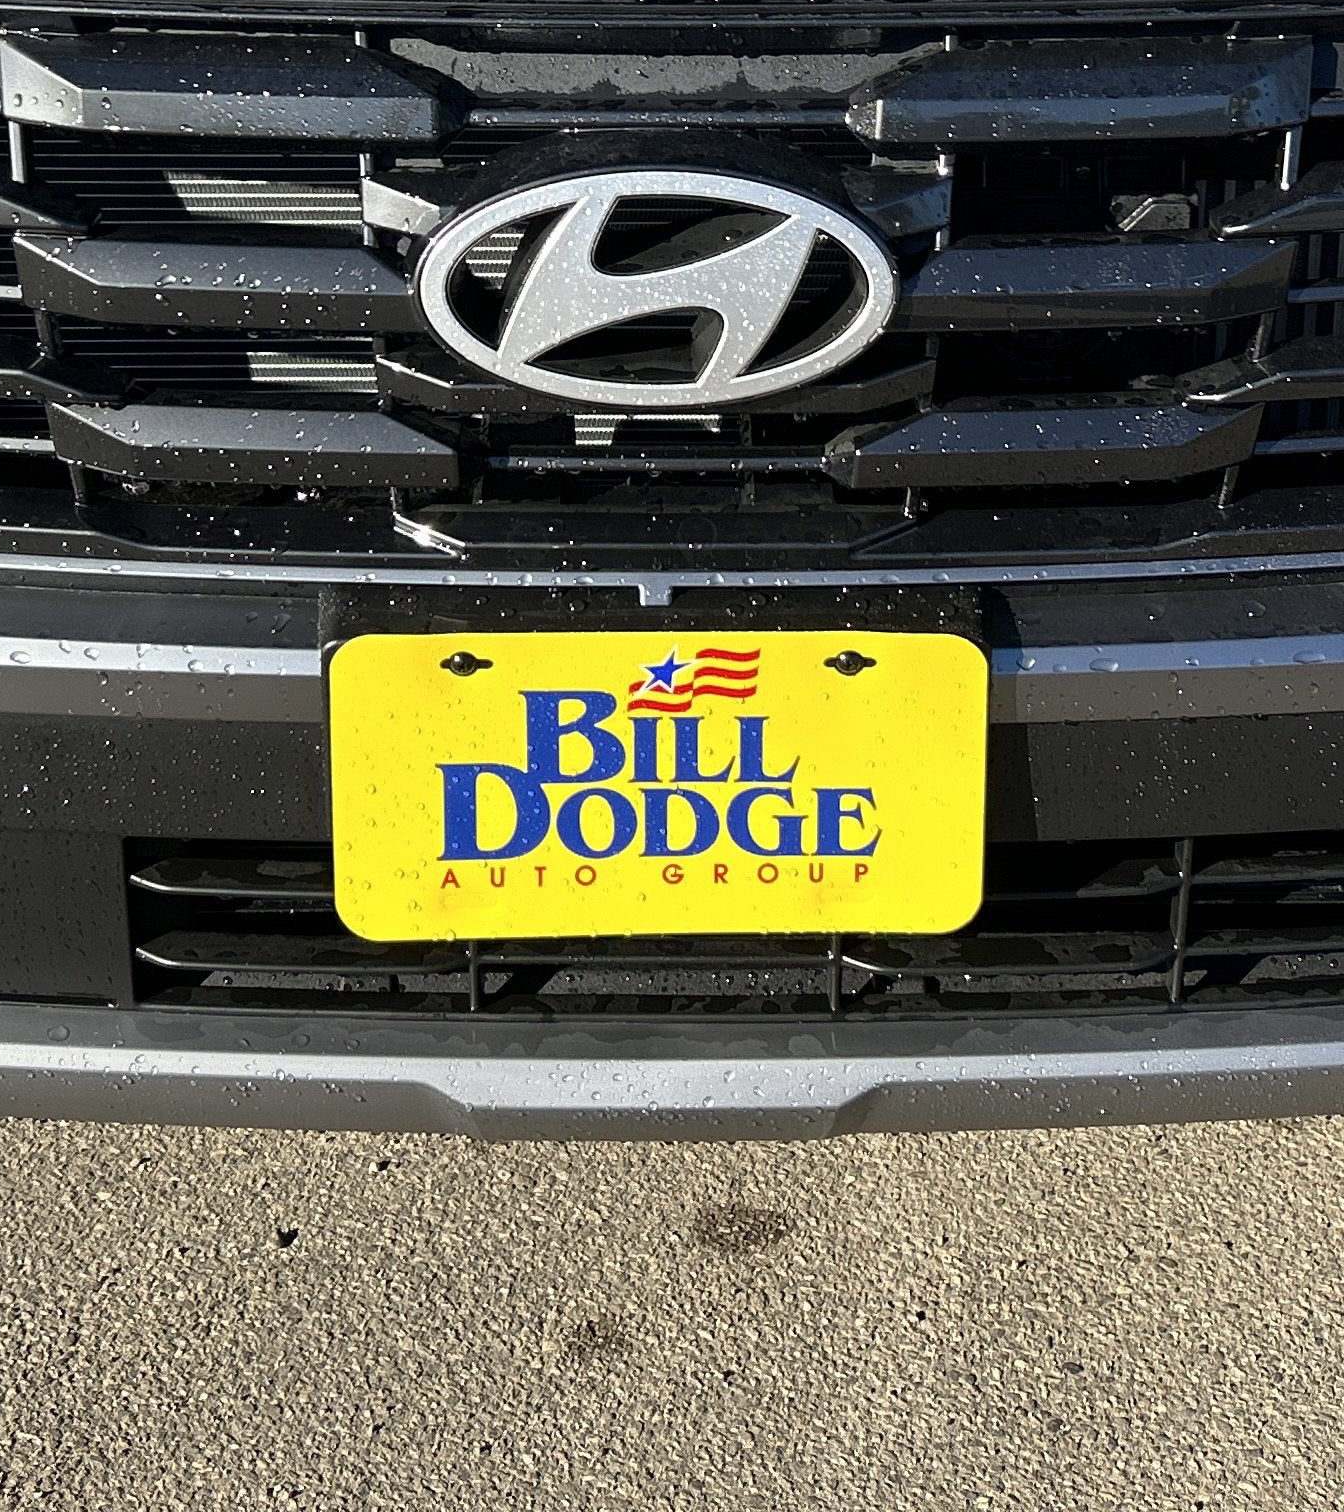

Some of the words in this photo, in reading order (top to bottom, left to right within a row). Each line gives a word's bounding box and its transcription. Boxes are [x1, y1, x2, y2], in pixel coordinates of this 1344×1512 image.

[518, 690, 800, 784] BILL
[435, 762, 883, 861] DODGE
[440, 864, 598, 889] AUTO
[661, 862, 872, 886] GROUP
